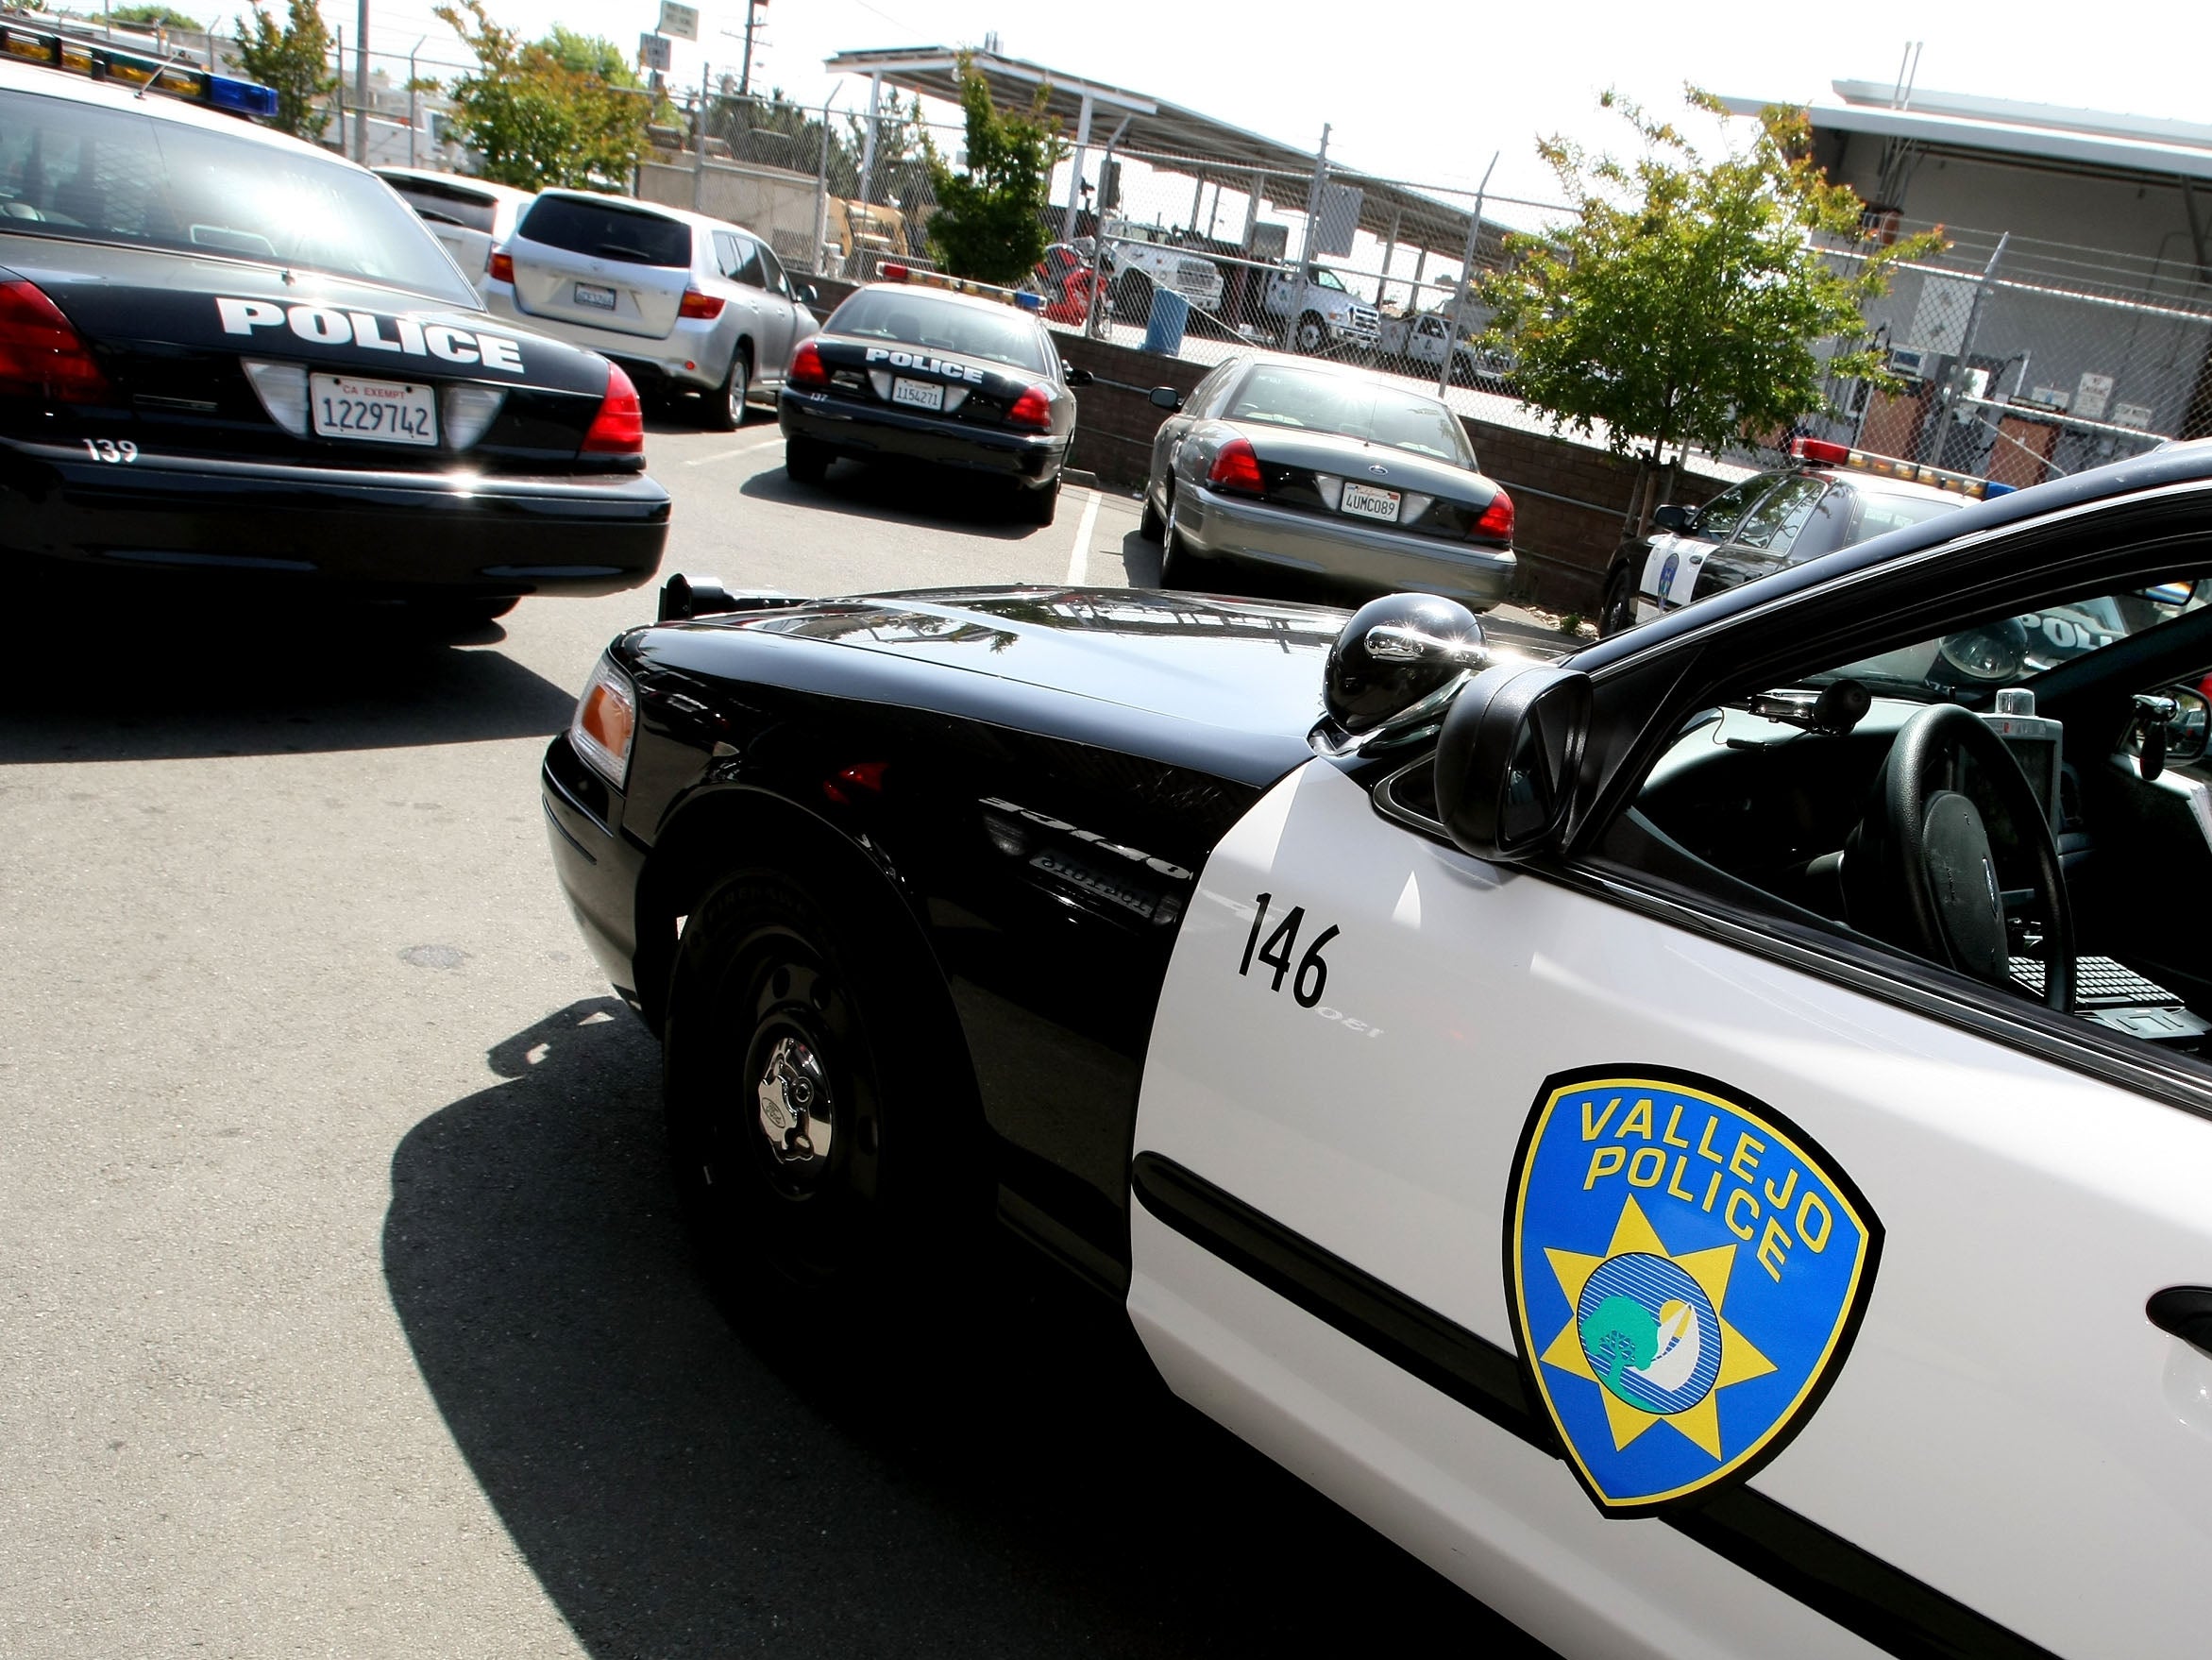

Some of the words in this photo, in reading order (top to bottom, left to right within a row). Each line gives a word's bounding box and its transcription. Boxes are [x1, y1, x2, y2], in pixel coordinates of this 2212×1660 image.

[217, 297, 524, 374] POLICE
[866, 347, 984, 384] POLICE
[342, 384, 360, 396] CA
[363, 386, 406, 400] EXEMPT
[896, 386, 938, 407] 1154271
[323, 398, 430, 436] 1229742
[83, 438, 139, 464] 139
[1346, 494, 1395, 517] 4UMC089
[1240, 891, 1341, 1008] 146
[1580, 1096, 1834, 1302] VALLEJO
[1582, 1145, 1792, 1284] POLICE
